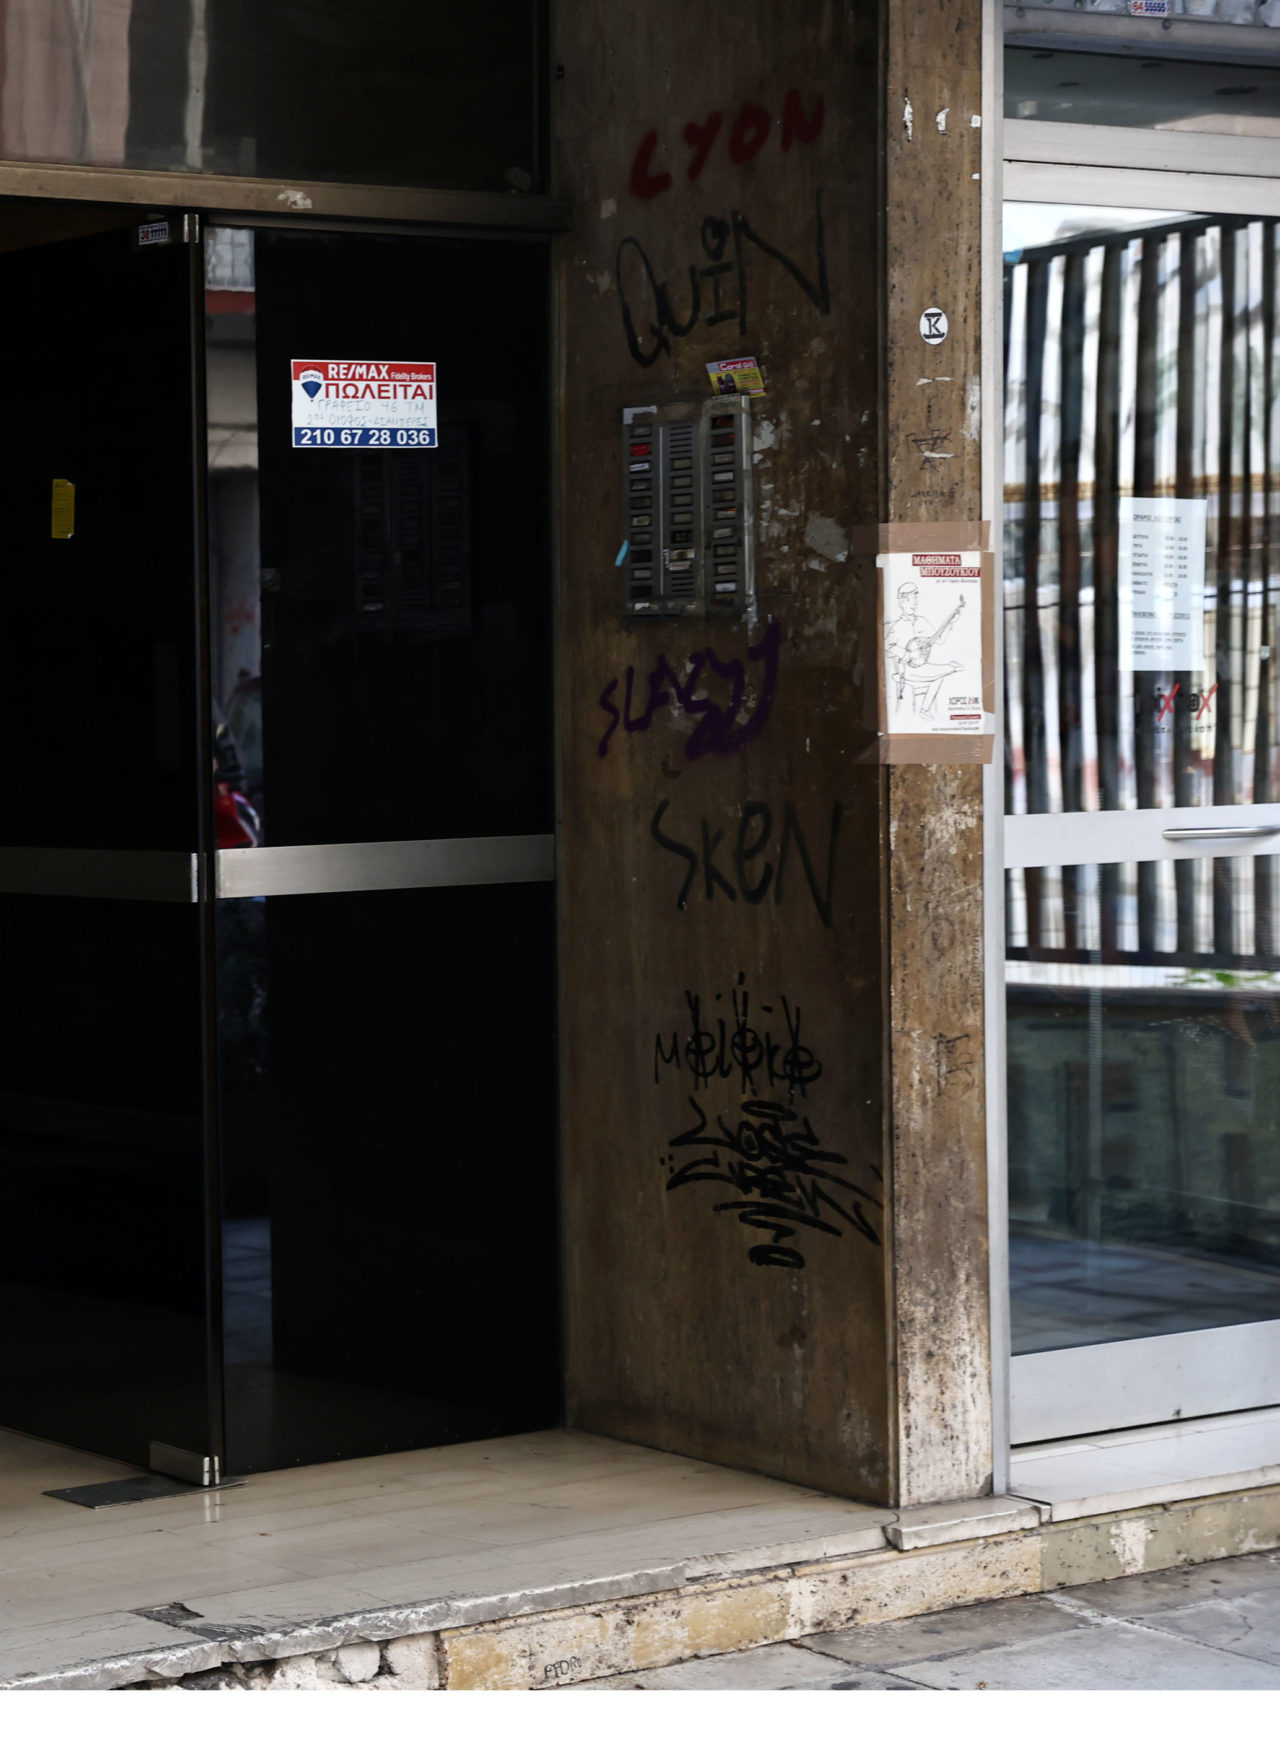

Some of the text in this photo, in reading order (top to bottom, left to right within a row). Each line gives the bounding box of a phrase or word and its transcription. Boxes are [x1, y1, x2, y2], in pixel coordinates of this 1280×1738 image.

[627, 87, 825, 201] LYON
[328, 364, 432, 382] RE/MAX Fidelity Brokers
[325, 383, 433, 400] ΠΩΛΕΙΤΑΙ
[300, 429, 430, 445] 210 67 28 036
[913, 555, 961, 565] ΜΑΘΗΜΑΤΑ
[920, 567, 980, 577] ΜΠΟΥΖΟΥΚΙΟΥ
